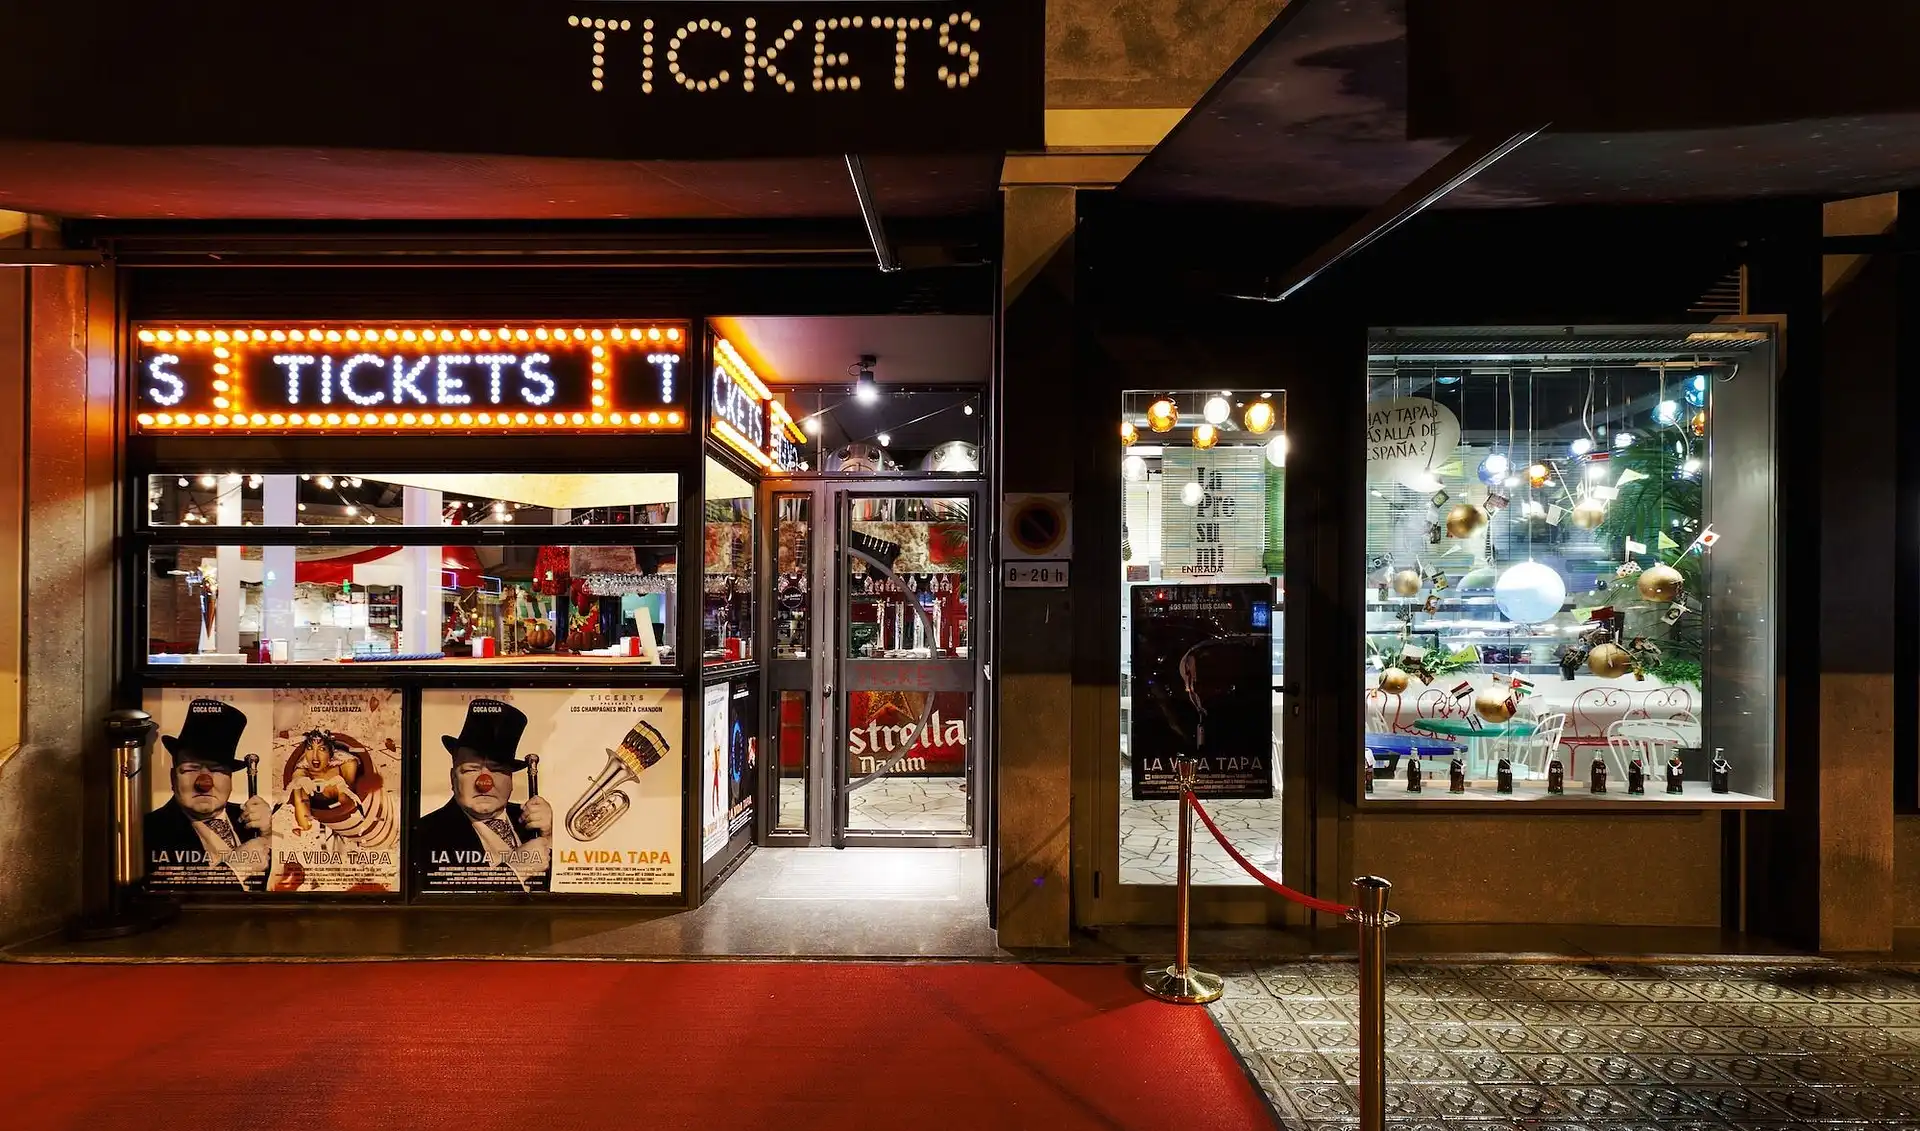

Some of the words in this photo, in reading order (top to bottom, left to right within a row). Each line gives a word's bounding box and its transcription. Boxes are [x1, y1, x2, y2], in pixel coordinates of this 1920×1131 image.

[568, 11, 980, 94] TICKETS
[149, 353, 184, 405] S
[273, 353, 554, 405] TICKETS
[647, 353, 680, 404] T
[1395, 404, 1438, 422] TAPAS
[1384, 421, 1415, 441] ALLÁ
[1421, 421, 1442, 436] DE
[1143, 758, 1163, 771] LA
[1169, 757, 1210, 772] VA
[1216, 757, 1263, 770] TAPA
[151, 850, 170, 863] LA
[175, 850, 213, 863] VIDA
[218, 850, 262, 863] TAPA
[279, 851, 298, 864] LA
[303, 851, 342, 864] VIDA
[347, 850, 392, 864] TAPA
[431, 850, 450, 864] LA
[455, 850, 494, 864] VIDA
[499, 850, 542, 864] TAPA
[560, 851, 579, 863] LA
[584, 851, 622, 863] VIDA
[628, 851, 671, 864] TAPA
